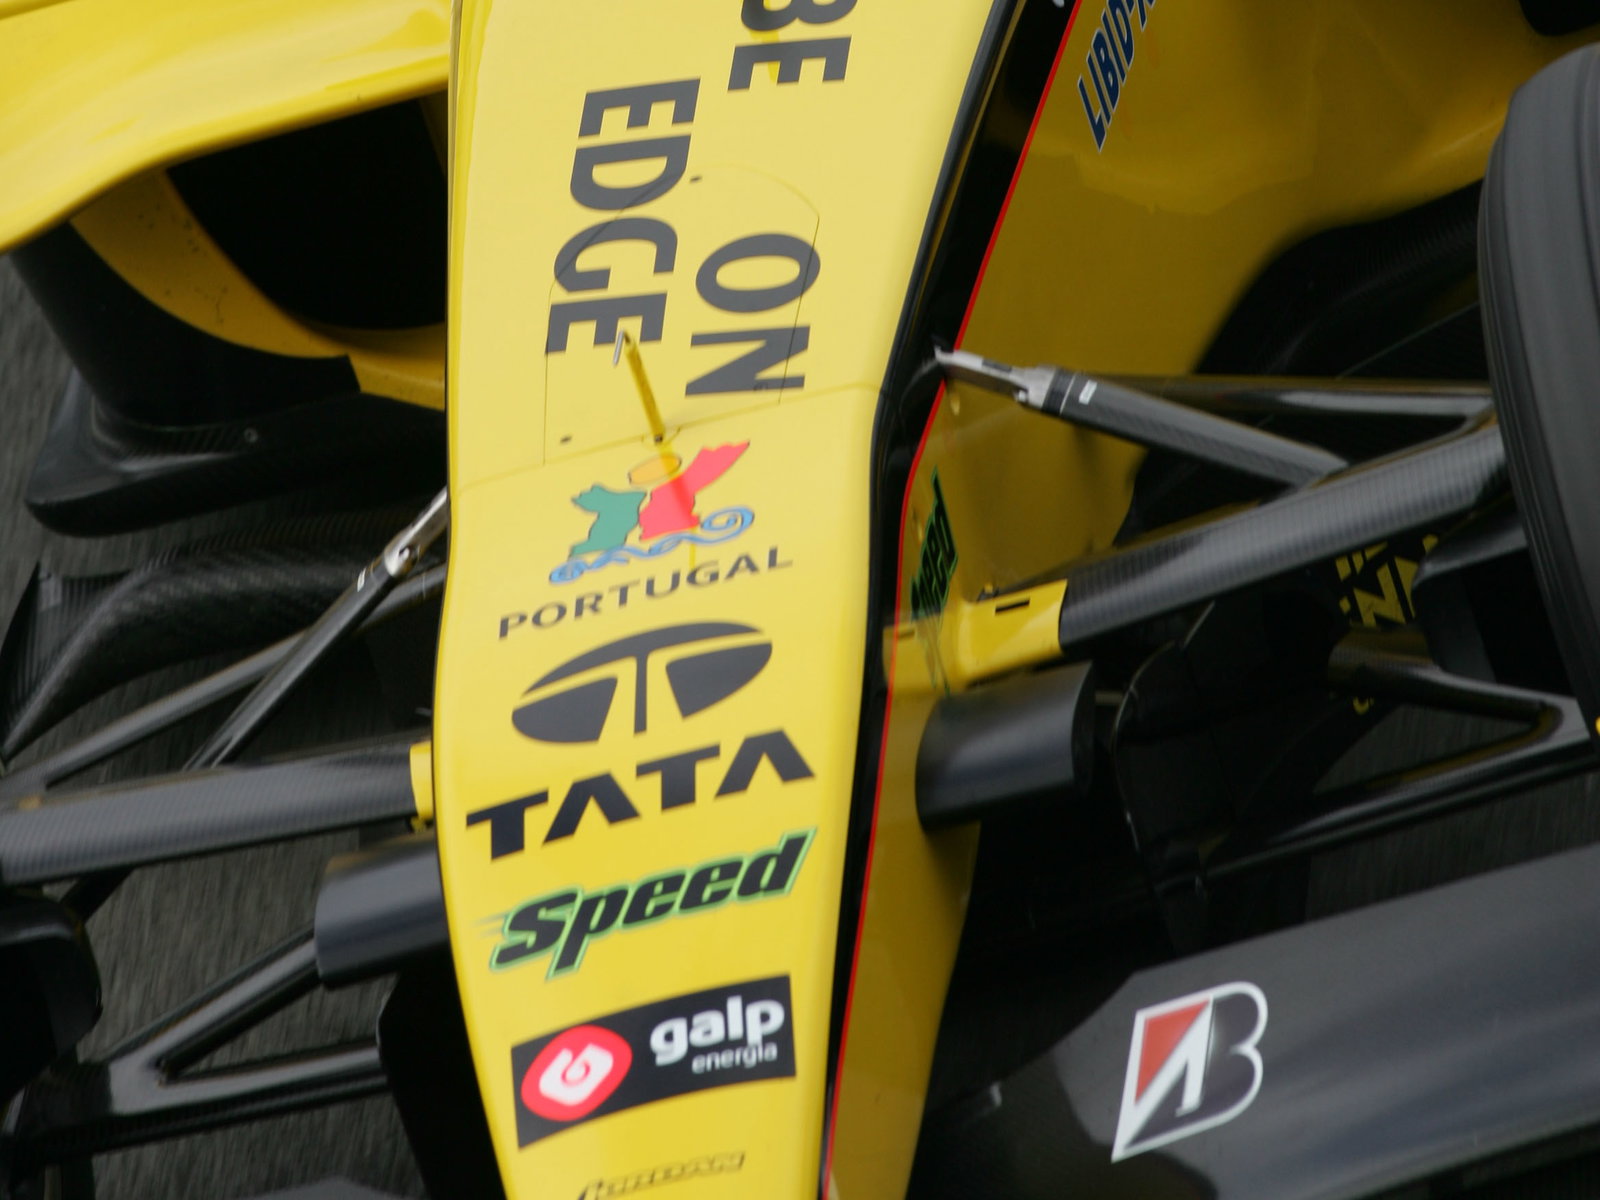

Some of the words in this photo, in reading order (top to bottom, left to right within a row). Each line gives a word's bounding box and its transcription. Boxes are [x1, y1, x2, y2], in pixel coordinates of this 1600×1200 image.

[545, 78, 700, 355] EDGE
[685, 233, 821, 397] ON
[499, 547, 793, 640] PORTUGAL
[466, 730, 815, 862] TATA
[488, 826, 817, 981] Speed
[649, 995, 785, 1065] galp
[691, 1042, 778, 1074] energia
